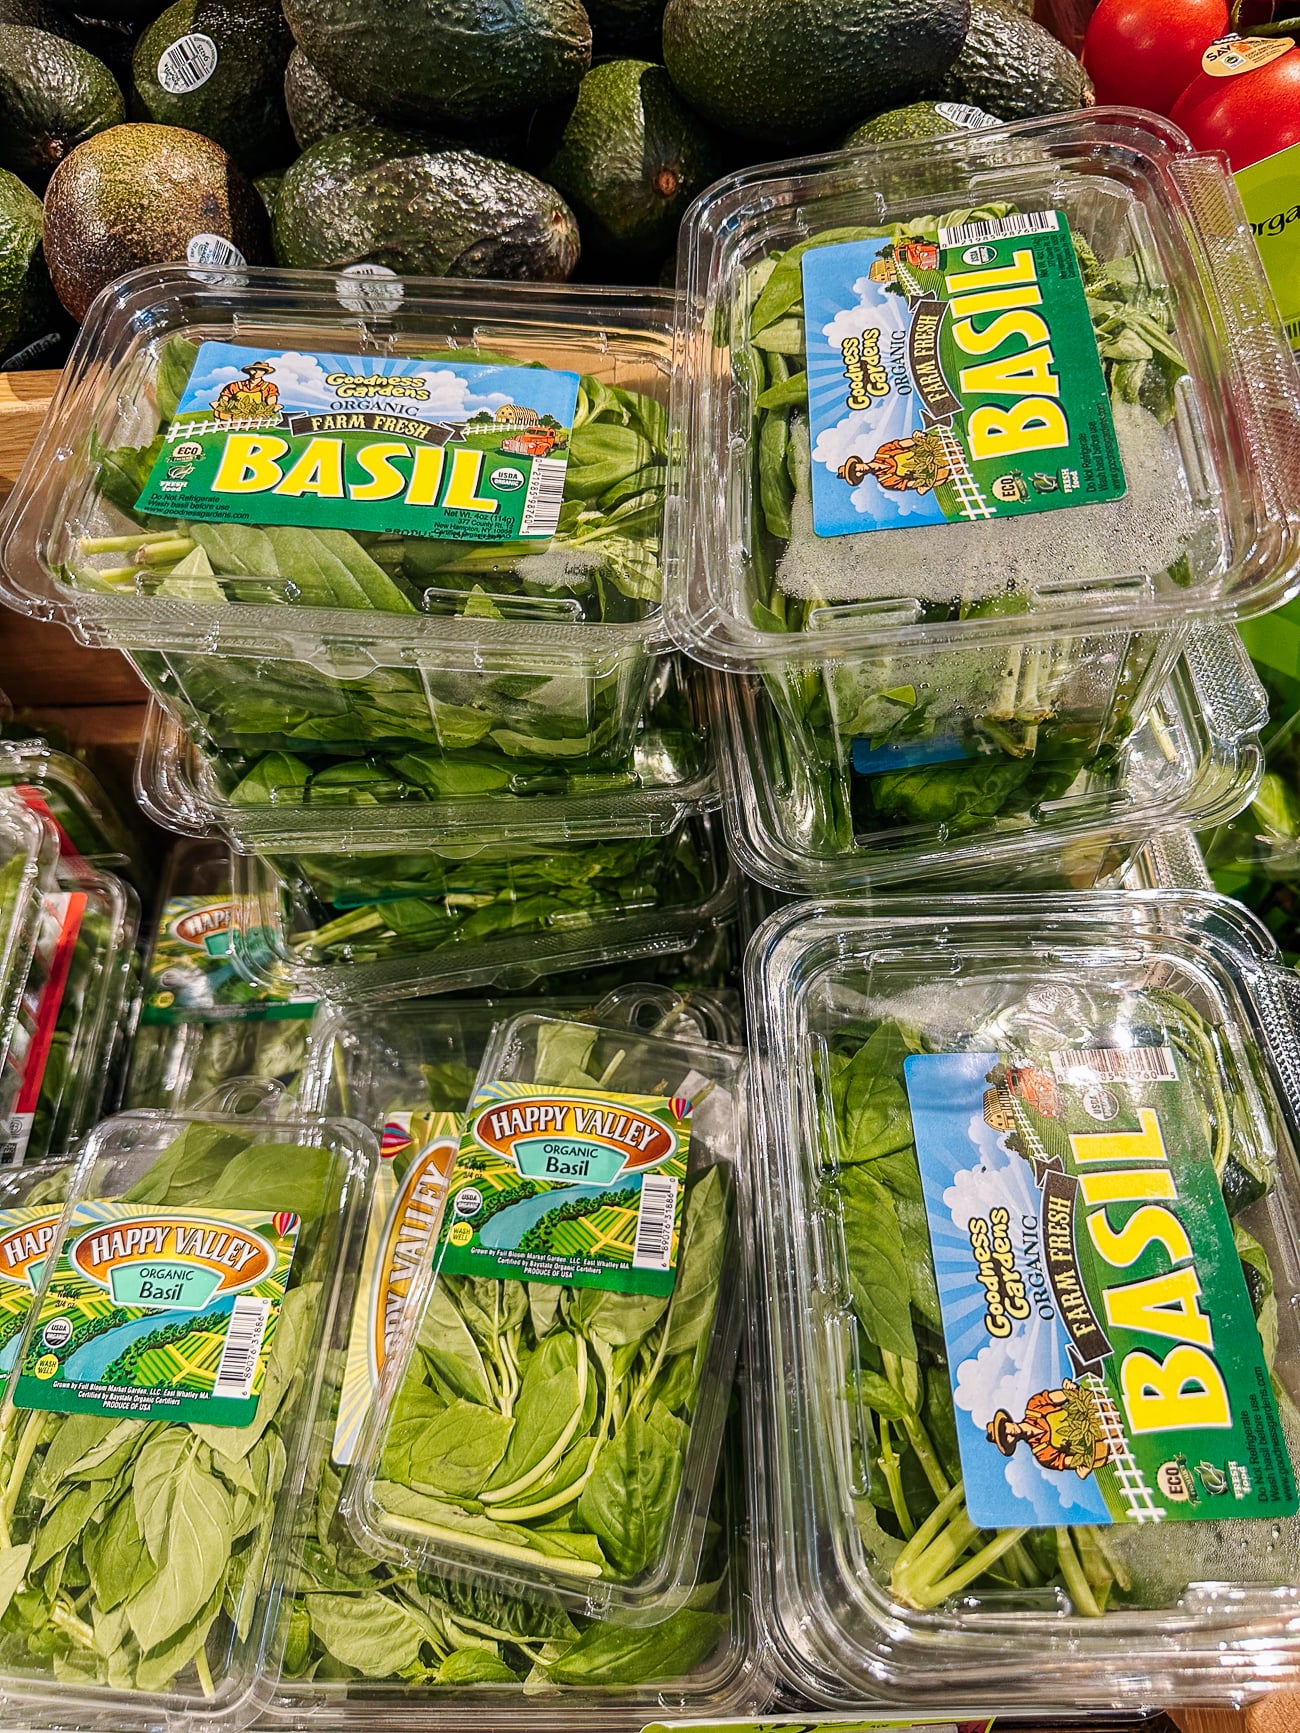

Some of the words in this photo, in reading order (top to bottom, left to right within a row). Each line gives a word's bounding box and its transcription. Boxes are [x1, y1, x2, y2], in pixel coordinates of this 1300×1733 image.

[914, 315, 940, 358] FRESH
[862, 328, 891, 397] Gardens
[891, 330, 912, 396] ORGANIC
[945, 250, 1069, 461] BASIL
[325, 373, 427, 388] Goodness
[841, 337, 872, 410] Goodness
[916, 360, 950, 403] FARM
[336, 384, 431, 401] Gardens
[330, 401, 420, 416] ORGANIC
[311, 414, 366, 432] FARM
[372, 415, 432, 439] FRESH
[177, 446, 199, 455] ECO
[1079, 433, 1091, 469] Refrigerate
[211, 433, 500, 514] BASIL
[498, 471, 518, 480] USDA
[529, 471, 541, 496] 21985
[180, 495, 220, 503] Refrigerate
[1001, 478, 1016, 497] ECO
[1086, 485, 1097, 493] Do
[190, 502, 214, 510] before
[444, 509, 458, 517] Net
[490, 515, 515, 524] (114g)
[524, 499, 537, 524] 98760
[471, 520, 493, 528] County
[490, 1106, 569, 1141] HAPPY
[573, 1107, 661, 1152] VALLEY
[543, 1143, 599, 1159] ORGANIC
[546, 1157, 589, 1176] Basil
[664, 1192, 675, 1220] 31886
[388, 1160, 449, 1284] VALLEY
[1048, 1196, 1073, 1262] FRESH
[90, 1226, 171, 1266] HAPPY
[176, 1226, 260, 1271] VALLEY
[661, 1223, 671, 1252] 89076
[489, 1248, 496, 1256] by
[508, 1250, 526, 1258] Bloom
[527, 1252, 546, 1260] Market
[583, 1258, 596, 1266] East
[497, 1257, 521, 1265] Certified
[521, 1259, 529, 1267] by
[553, 1262, 575, 1271] Organic
[576, 1265, 602, 1274] Certifiers
[990, 1206, 1031, 1320] Gardens
[1022, 1214, 1055, 1320] ORGANIC
[139, 1267, 195, 1281] ORGANIC
[524, 1267, 551, 1276] PRODUCE
[551, 1269, 560, 1277] OF
[561, 1270, 573, 1278] USA
[968, 1217, 1012, 1338] Goodness
[1068, 1107, 1233, 1435] BASIL
[139, 1281, 184, 1301] Basil
[1054, 1269, 1097, 1338] FARM
[244, 1349, 257, 1379] 89076
[251, 1316, 264, 1345] 31886
[52, 1381, 70, 1389] Grown
[71, 1382, 78, 1390] by
[89, 1384, 107, 1392] Bloom
[108, 1385, 127, 1393] Market
[164, 1389, 176, 1397] East
[78, 1390, 101, 1399] Certified
[101, 1392, 109, 1401] by
[133, 1395, 155, 1404] Organic
[155, 1397, 181, 1406] Certifiers
[103, 1401, 130, 1409] PRODUCE
[130, 1402, 139, 1410] OF
[139, 1403, 151, 1411] USA
[1249, 1394, 1260, 1411] use
[1240, 1410, 1259, 1465] Refrigerate
[1253, 1416, 1268, 1445] before
[1255, 1366, 1293, 1502] www.goodnessgardens.com
[1261, 1449, 1273, 1471] basil
[1166, 1467, 1183, 1494] ECO
[1228, 1460, 1244, 1499] FRESH
[1237, 1465, 1251, 1494] food
[1255, 1467, 1265, 1484] Not
[1258, 1489, 1268, 1502] Do
[1265, 1476, 1280, 1502] Wash
